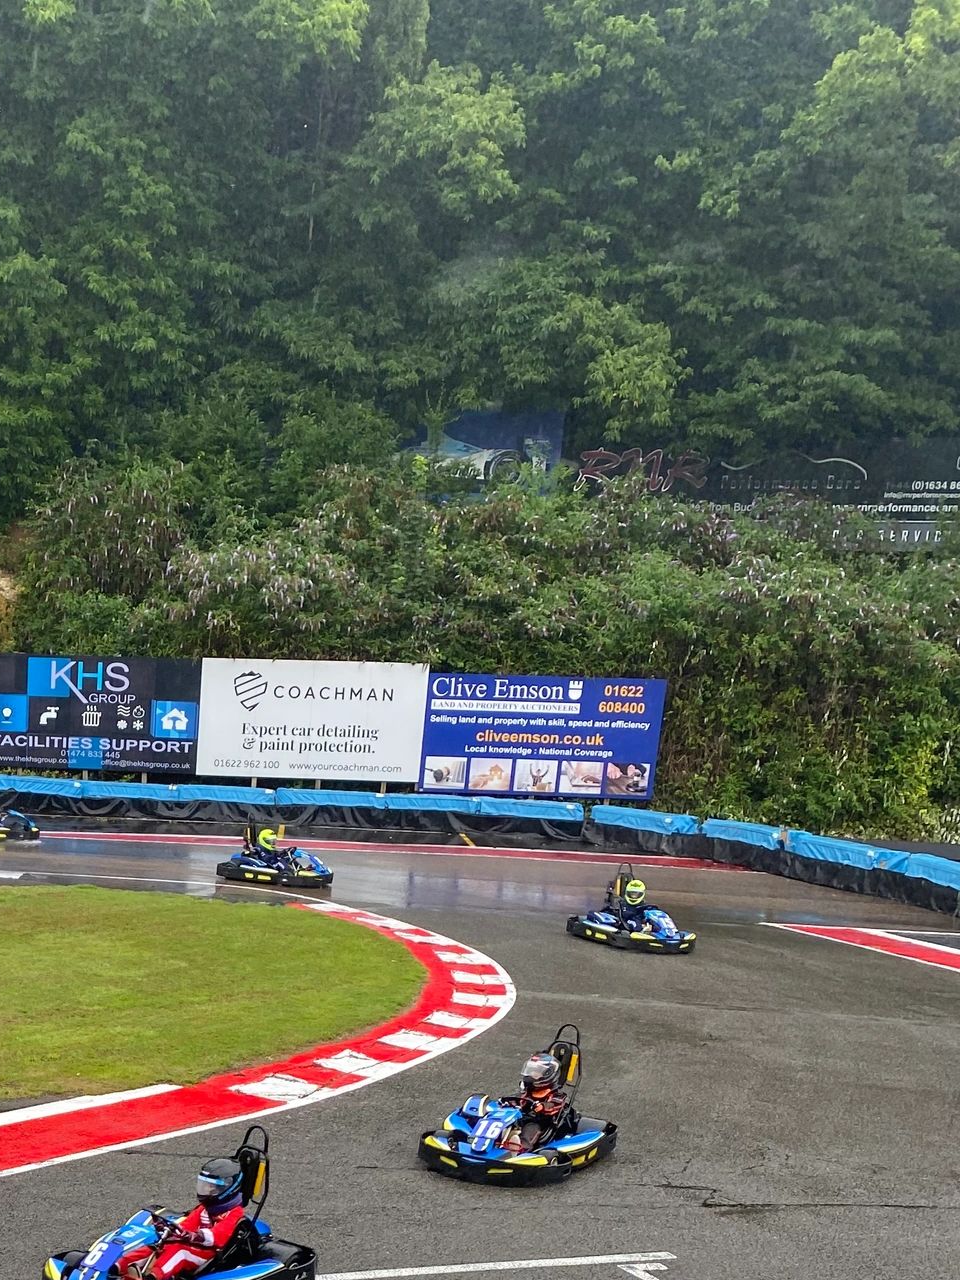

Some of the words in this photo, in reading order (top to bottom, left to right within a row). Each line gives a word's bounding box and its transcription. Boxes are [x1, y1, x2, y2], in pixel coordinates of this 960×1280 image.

[50, 660, 130, 703] KHS
[432, 677, 487, 697] Clive
[493, 679, 564, 700] Emson
[88, 693, 136, 704] GROUP
[274, 685, 394, 701] COACHMAN
[604, 685, 644, 698] 01622
[433, 700, 456, 708] LAND
[476, 702, 518, 710] PROPERTY
[520, 704, 579, 712] AUCTIONEERS
[598, 702, 646, 714] 608400
[430, 714, 457, 724] Selling
[459, 716, 476, 724] land
[477, 716, 493, 724] and
[494, 718, 528, 726] property
[529, 718, 546, 726] with
[568, 720, 592, 728] speed
[594, 720, 609, 728] and
[611, 721, 650, 730] efficiency
[242, 722, 288, 738] Expert
[290, 726, 314, 736] car
[317, 724, 380, 740] detailing
[476, 729, 604, 746] cliveemson.co.uk
[99, 738, 193, 753] SUPPORT
[242, 738, 256, 749] &
[259, 738, 294, 752] paint
[299, 740, 376, 754] protection.
[465, 745, 487, 753] Local
[489, 746, 532, 755] knowledge
[539, 747, 572, 755] National
[574, 749, 613, 758] Coverage
[61, 750, 85, 758] 01474
[101, 759, 190, 769] office@thekhsgroup.co.uk
[214, 759, 241, 768] 01622
[244, 759, 260, 768] 962
[263, 760, 280, 769] 100
[289, 762, 402, 773] www.yourcoachman.com
[475, 1120, 503, 1138] 16
